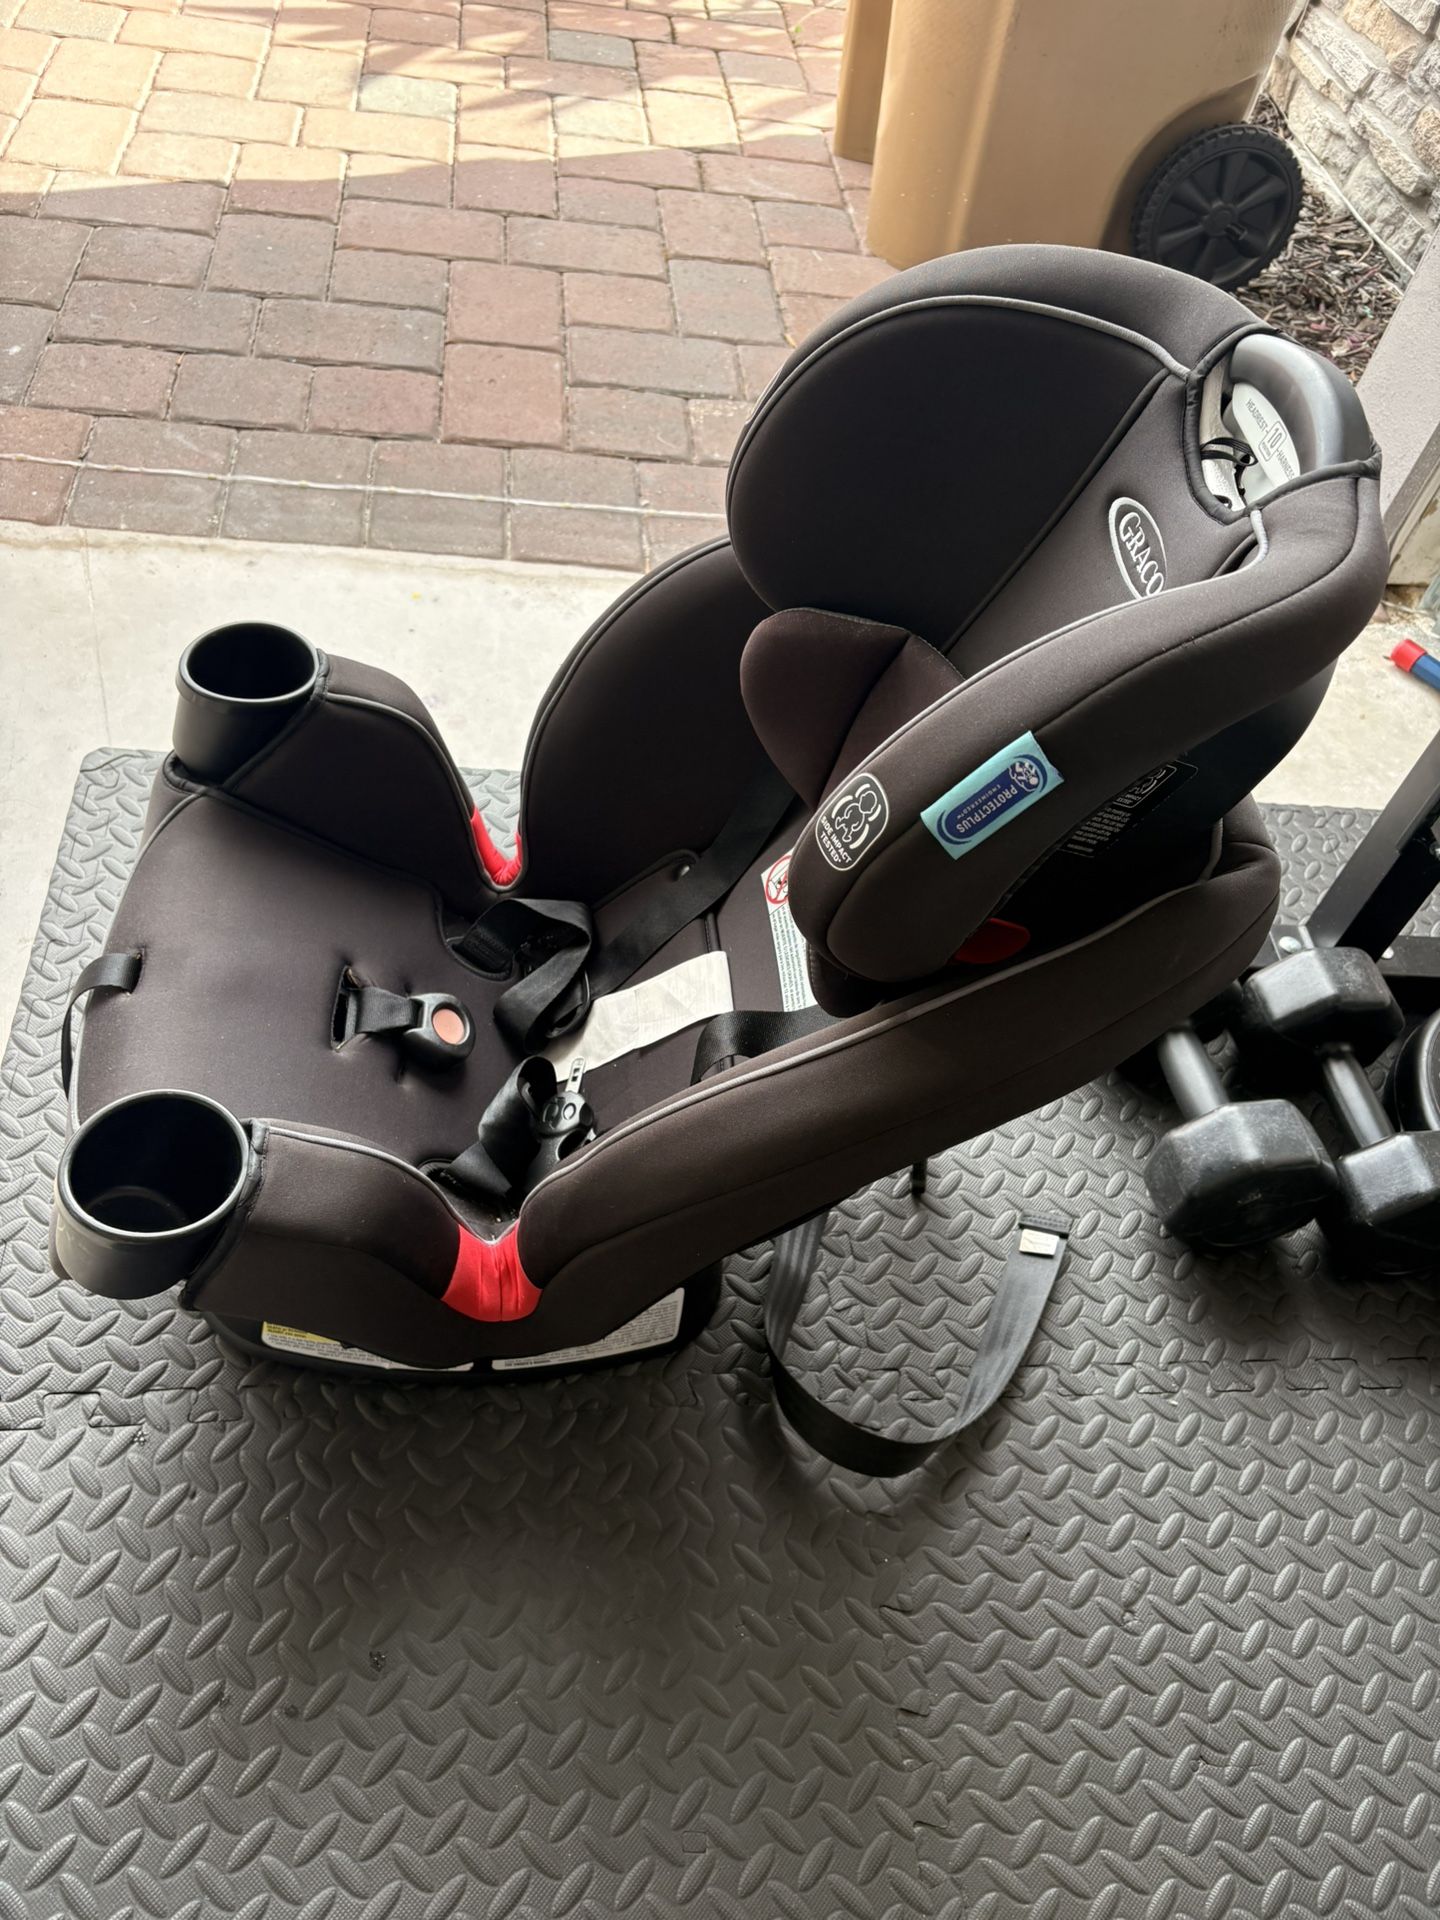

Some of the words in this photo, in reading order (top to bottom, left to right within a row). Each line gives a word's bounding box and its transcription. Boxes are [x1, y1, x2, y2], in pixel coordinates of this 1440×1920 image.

[1245, 398, 1269, 432] HEADREST
[1267, 427, 1283, 449] 10
[1118, 511, 1165, 596] GRACO
[956, 784, 1018, 833] PROTECTPLUS
[820, 815, 834, 836] SIDE
[830, 832, 853, 864] IMPACT
